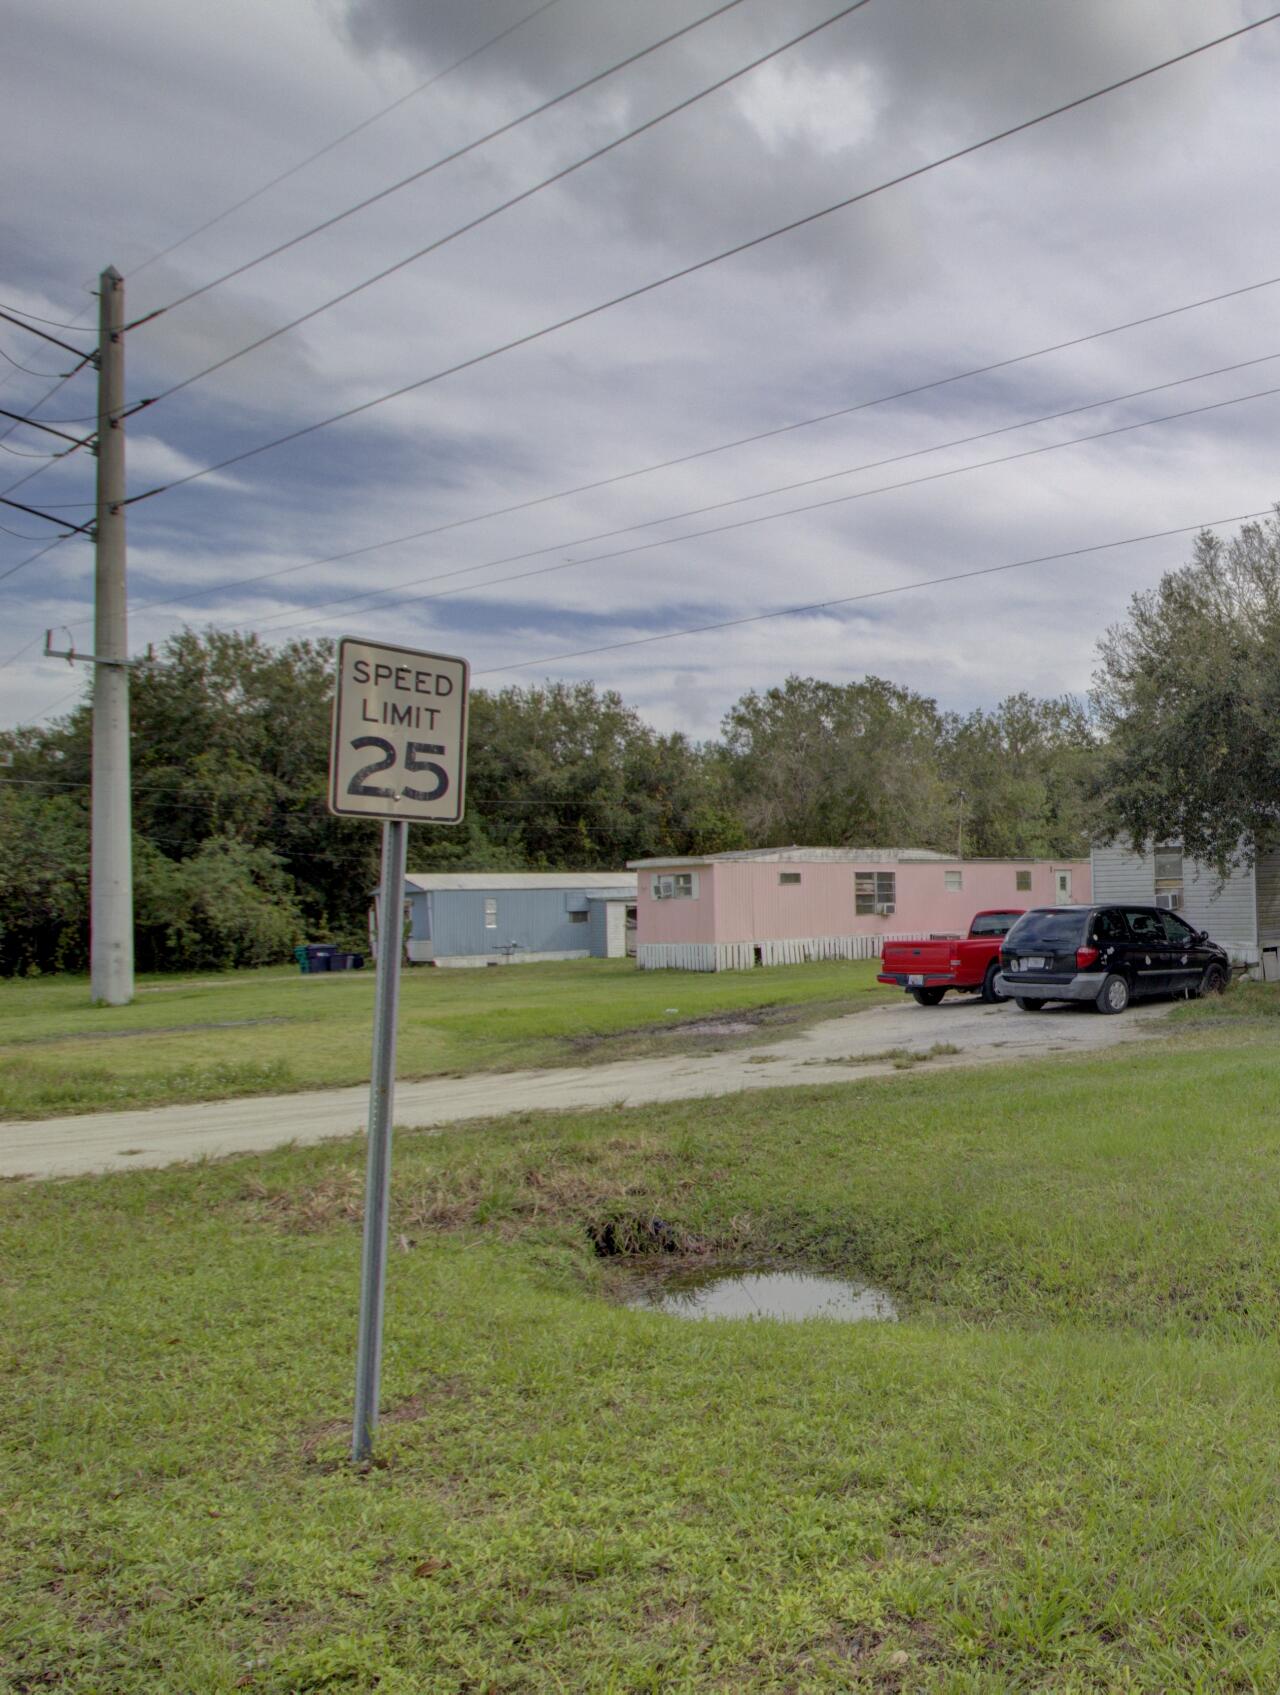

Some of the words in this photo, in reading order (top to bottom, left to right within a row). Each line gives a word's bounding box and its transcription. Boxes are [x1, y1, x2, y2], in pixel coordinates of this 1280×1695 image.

[352, 660, 453, 697] SPEED
[362, 698, 441, 730] LIMIT
[347, 736, 449, 801] 25
